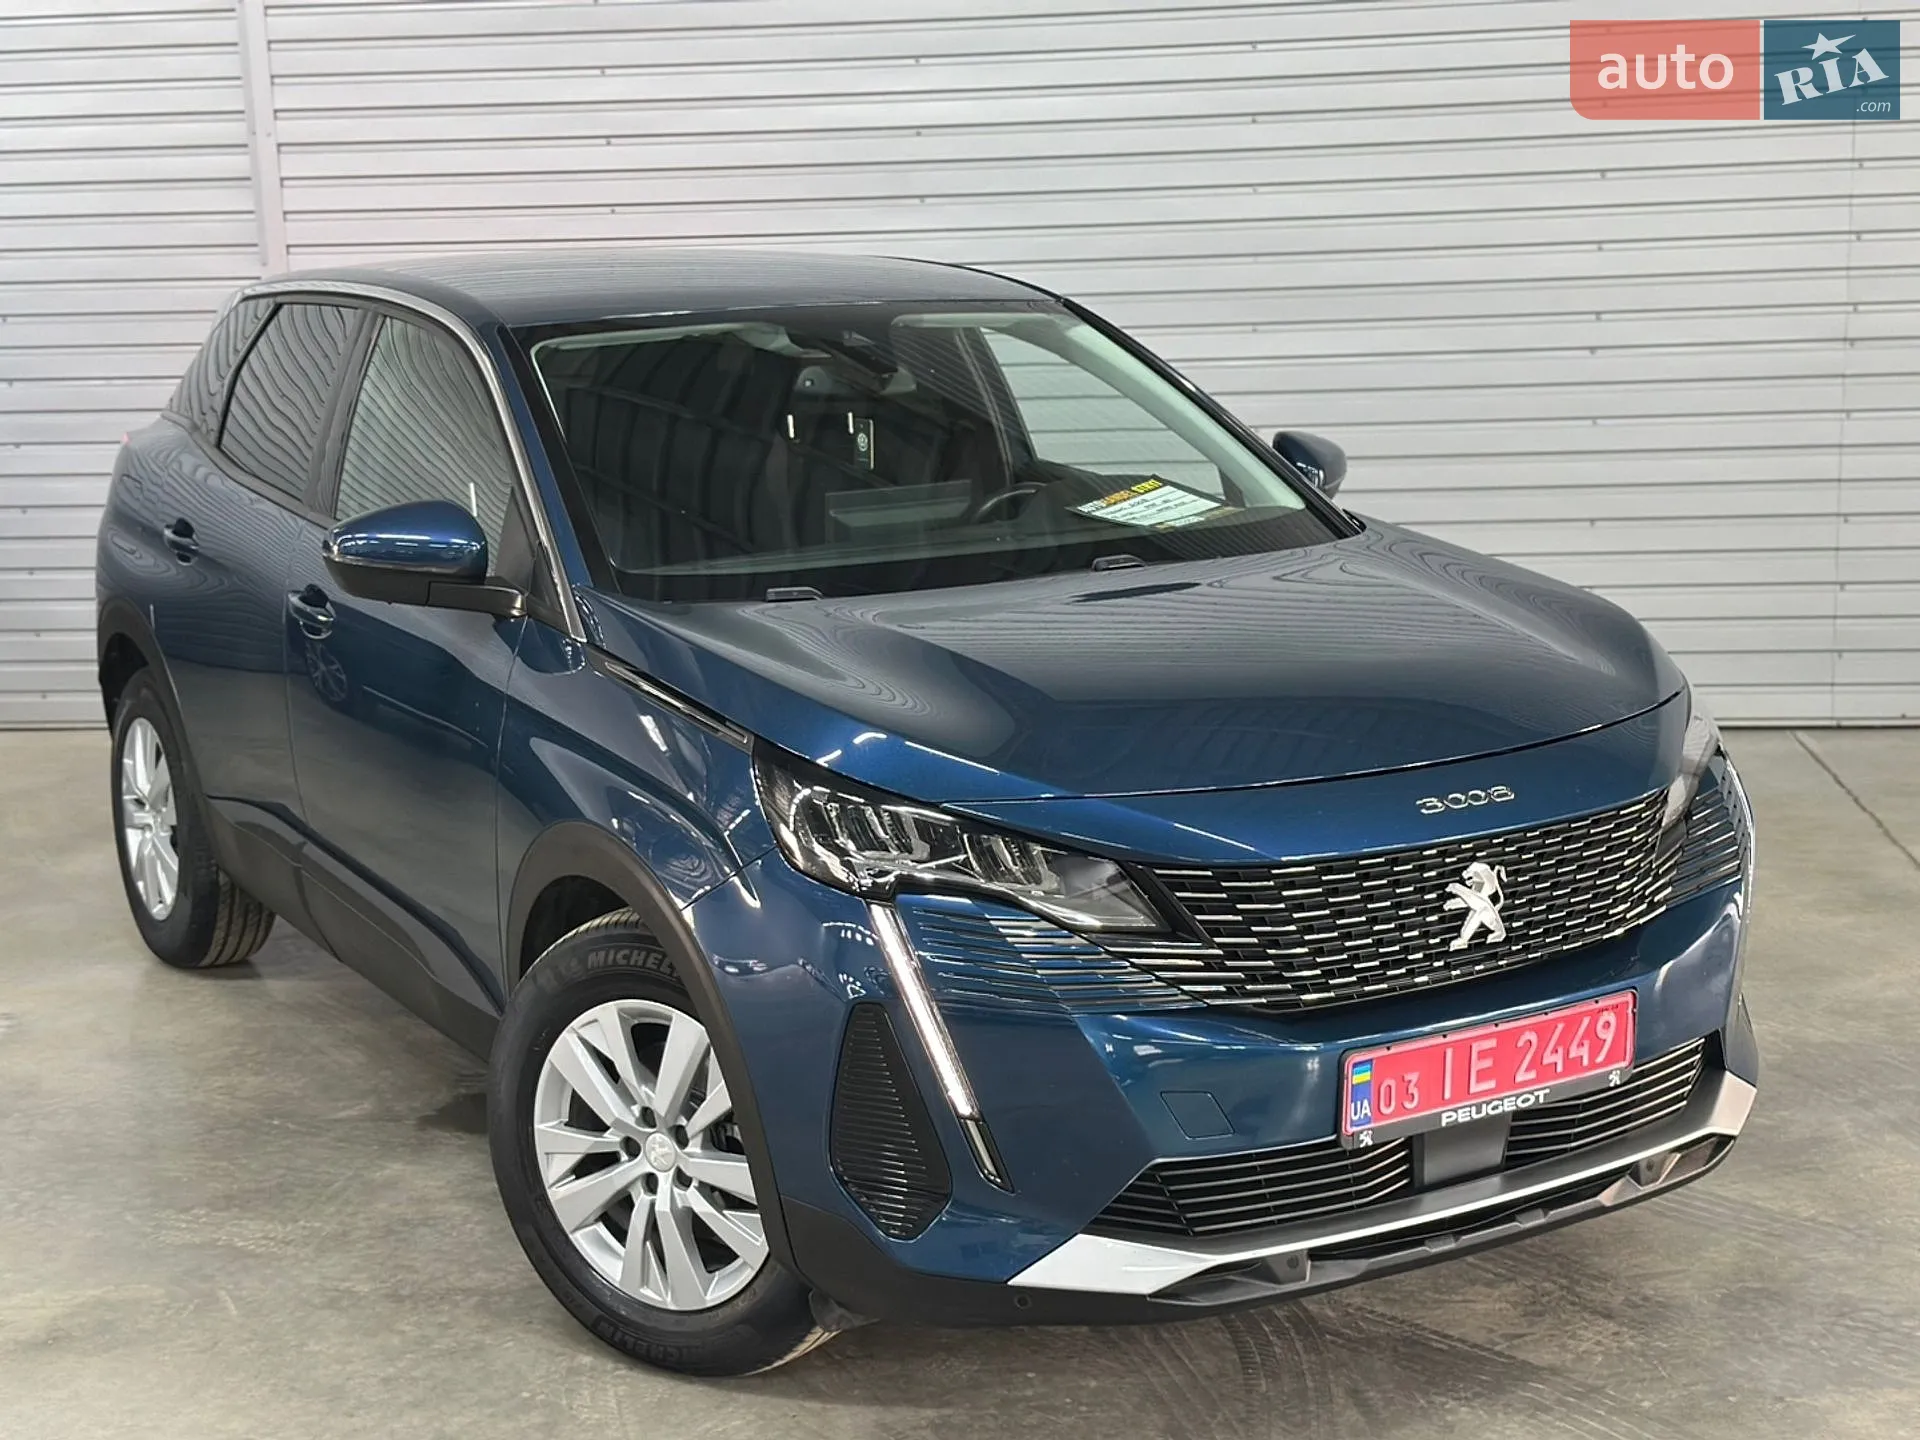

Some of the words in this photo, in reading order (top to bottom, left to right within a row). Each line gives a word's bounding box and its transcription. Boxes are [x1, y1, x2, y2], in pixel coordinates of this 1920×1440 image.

[1415, 785, 1515, 815] 3008
[587, 949, 679, 977] MICHEL
[1377, 1071, 1420, 1116] 03
[1443, 1038, 1498, 1100] IE
[1513, 1011, 1618, 1084] 2449
[1351, 1100, 1371, 1121] UA
[1440, 1088, 1550, 1127] PEUGEOT
